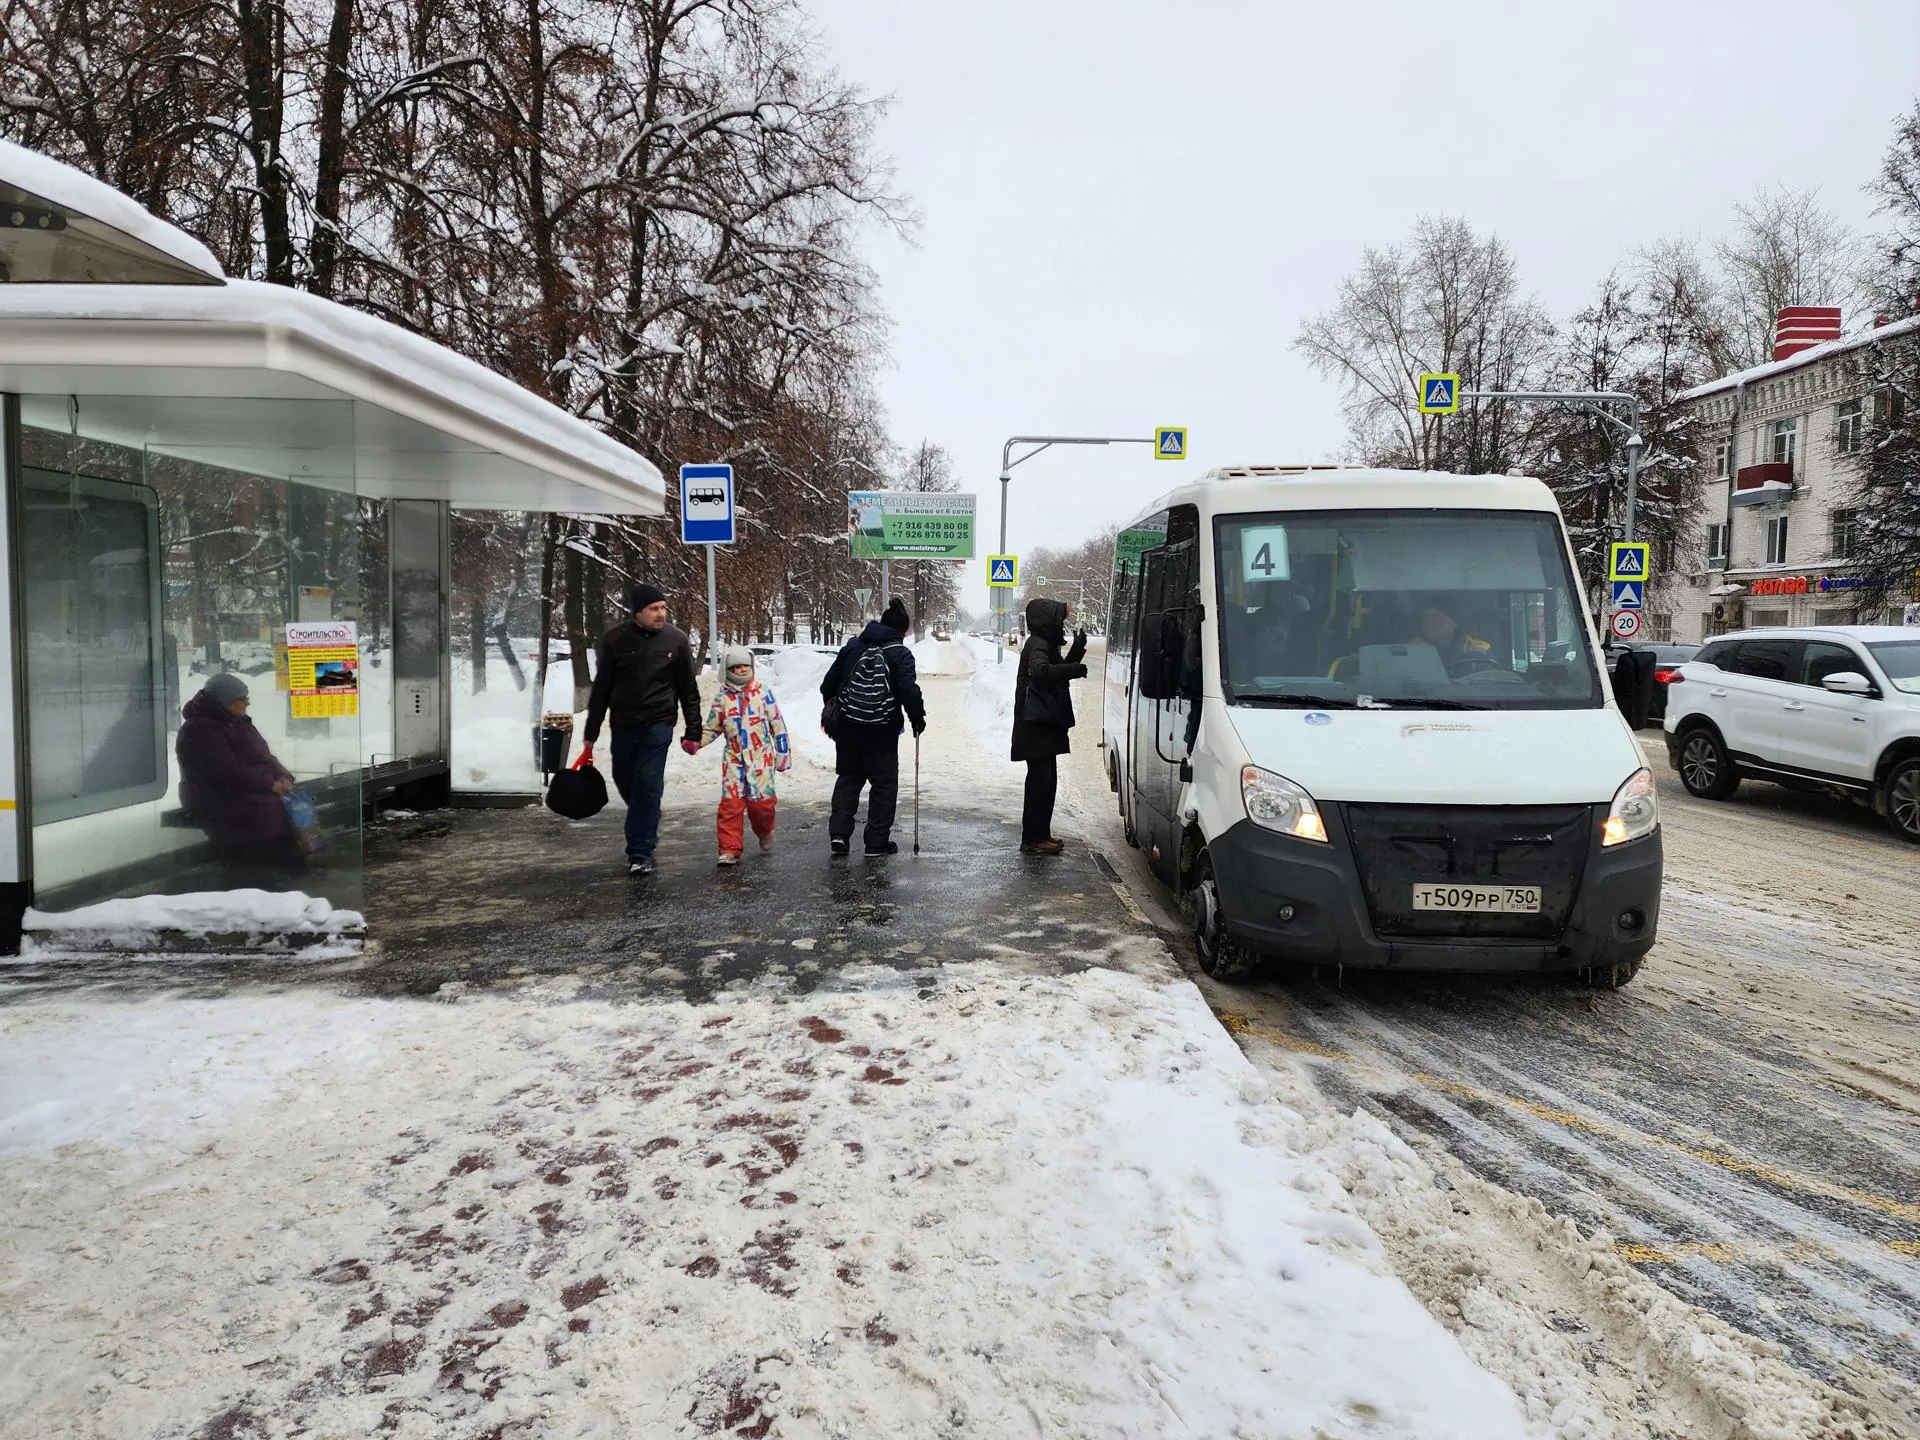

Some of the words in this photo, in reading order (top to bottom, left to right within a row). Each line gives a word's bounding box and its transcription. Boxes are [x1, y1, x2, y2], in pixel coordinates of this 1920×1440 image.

[926, 498, 974, 508] УЧАСТКИ
[891, 522, 903, 530] +7
[905, 522, 922, 530] 916
[924, 522, 941, 530] 439
[943, 522, 955, 530] 80
[957, 522, 969, 530] 08
[891, 531, 903, 539] +7
[905, 531, 922, 539] 926
[924, 531, 941, 539] 876
[943, 531, 955, 539] 50
[957, 531, 969, 539] 25
[1251, 542, 1276, 576] 4
[1618, 618, 1634, 629] 20
[1505, 889, 1535, 904] 750
